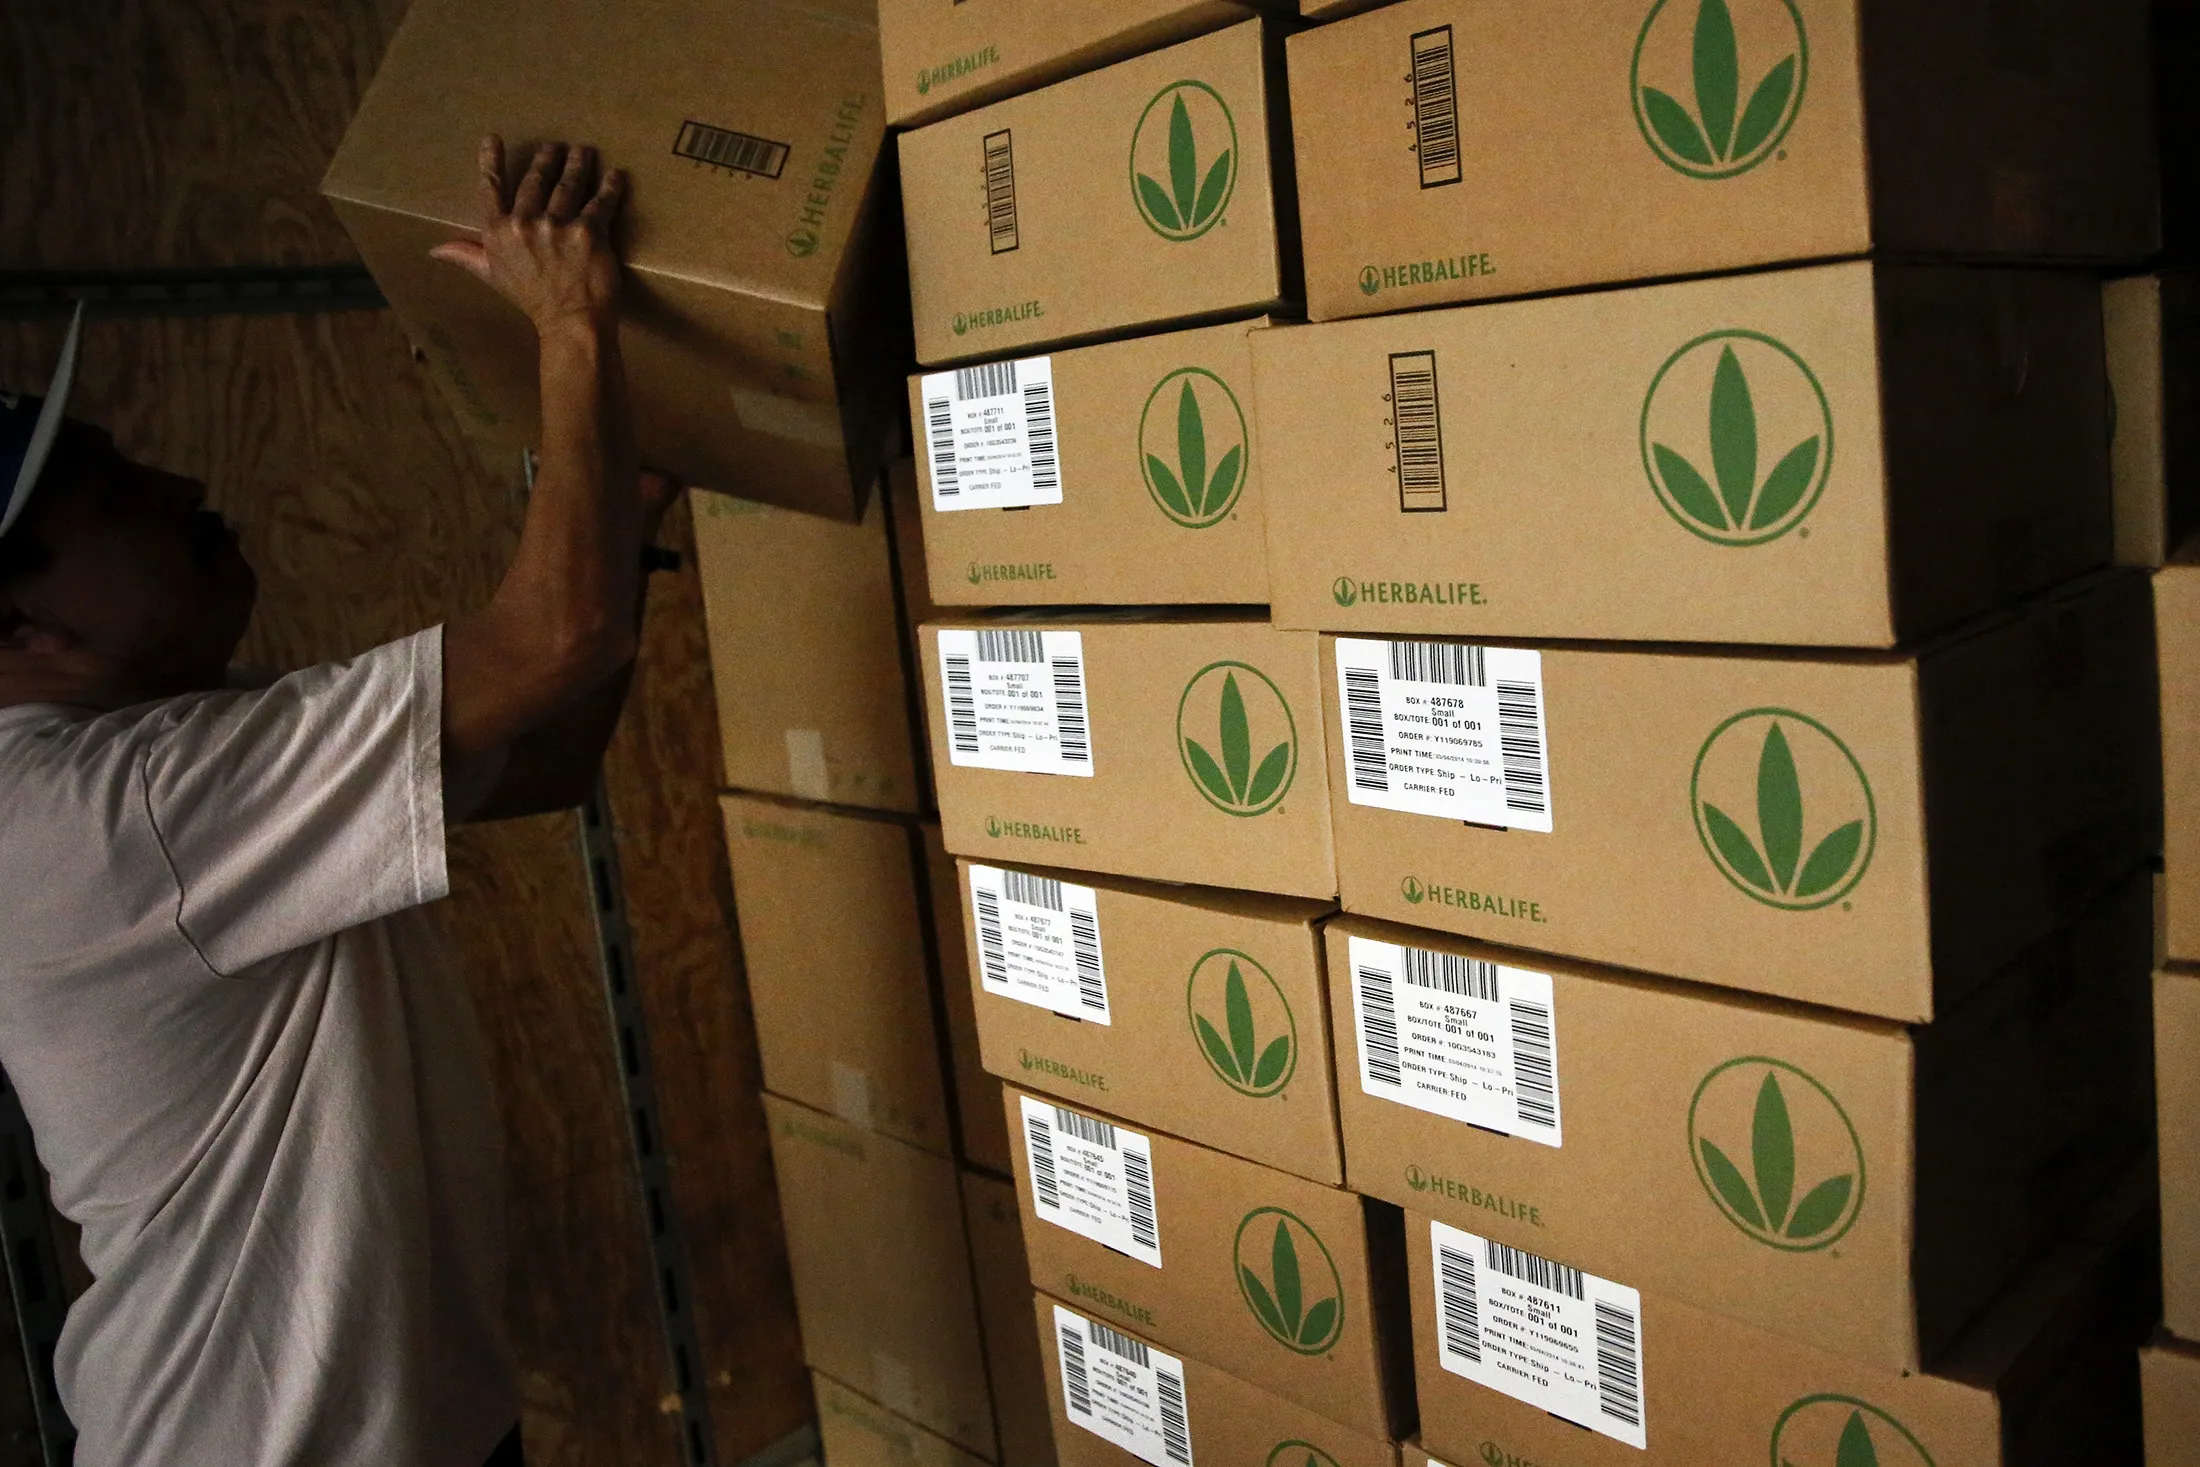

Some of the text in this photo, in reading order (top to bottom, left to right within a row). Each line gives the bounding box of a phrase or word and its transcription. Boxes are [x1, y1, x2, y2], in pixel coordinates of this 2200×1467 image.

[1431, 697, 1464, 708] 487678
[1431, 708, 1454, 717] Small
[1432, 717, 1448, 727] 001
[1453, 720, 1460, 728] of
[1464, 720, 1481, 730] 001
[1399, 731, 1423, 740] ORDER
[1434, 736, 1483, 747] Y119069785
[1391, 748, 1412, 756] PRINT
[1389, 763, 1413, 772] ORDER
[1437, 769, 1455, 780] Ship
[1439, 787, 1455, 796] FED
[1419, 1001, 1433, 1010] BOX
[1444, 1005, 1477, 1019] 487667
[1445, 1015, 1468, 1027] Small
[1412, 1033, 1436, 1044] ORDER
[1445, 1024, 1461, 1035] 001
[1466, 1030, 1474, 1038] of
[1478, 1031, 1494, 1042] 001
[1404, 1047, 1424, 1057] PRINT
[1402, 1061, 1426, 1073] ORDER
[1450, 1073, 1467, 1085] Ship
[1451, 1090, 1466, 1100] FED
[1501, 1288, 1516, 1298] BOX
[1527, 1296, 1560, 1313] 487611
[1527, 1304, 1551, 1319] Small
[1493, 1316, 1518, 1330] ORDER
[1528, 1313, 1544, 1325] 001
[1548, 1322, 1557, 1330] of
[1561, 1325, 1577, 1337] 001
[1484, 1327, 1505, 1340] PRINT
[1482, 1340, 1507, 1355] ORDER
[1531, 1359, 1549, 1372] Ship
[1532, 1375, 1548, 1386] FED
